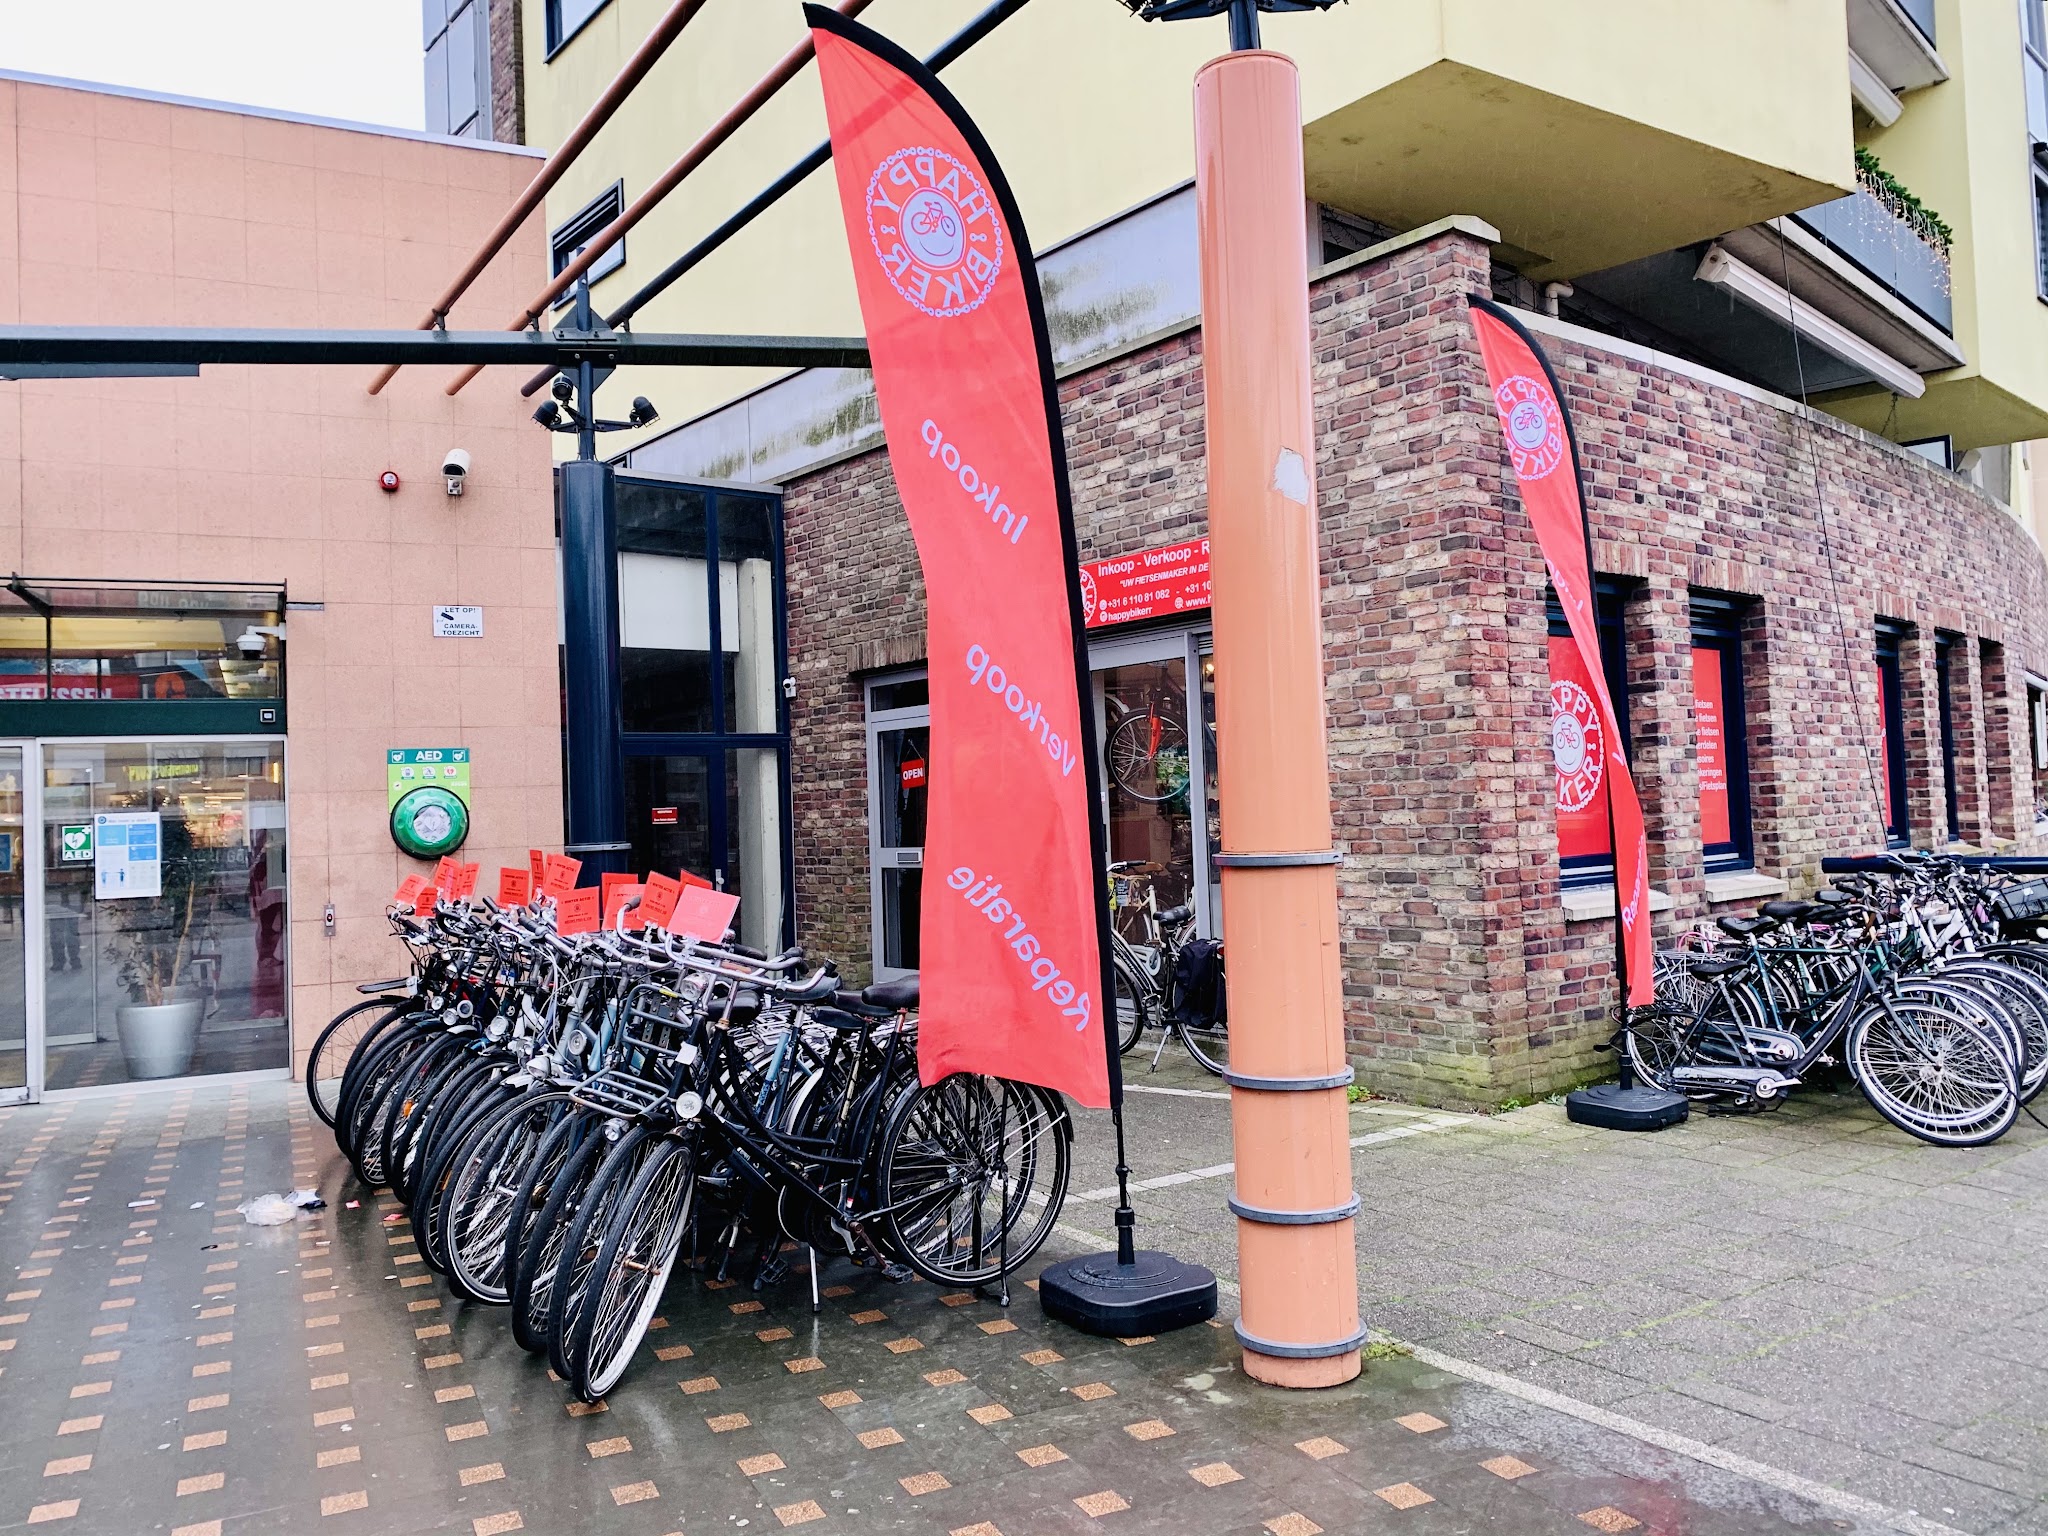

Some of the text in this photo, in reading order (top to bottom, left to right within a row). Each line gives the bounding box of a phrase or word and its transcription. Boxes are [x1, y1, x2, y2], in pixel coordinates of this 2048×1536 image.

[1098, 560, 1135, 577] Inkoop
[1143, 547, 1192, 567] Verkoop
[1135, 567, 1189, 585] FIETSENMAKER
[1189, 565, 1197, 574] IN
[1198, 562, 1209, 572] DE
[1108, 598, 1121, 608] +31
[1122, 596, 1128, 606] 6
[1129, 593, 1143, 605] 110
[1144, 591, 1154, 602] 81
[1155, 588, 1170, 600] 082
[1185, 582, 1199, 593] +31
[1550, 687, 1598, 733] APPY
[415, 750, 443, 761] AED
[902, 767, 924, 780] OPEN
[65, 850, 92, 859] AED
